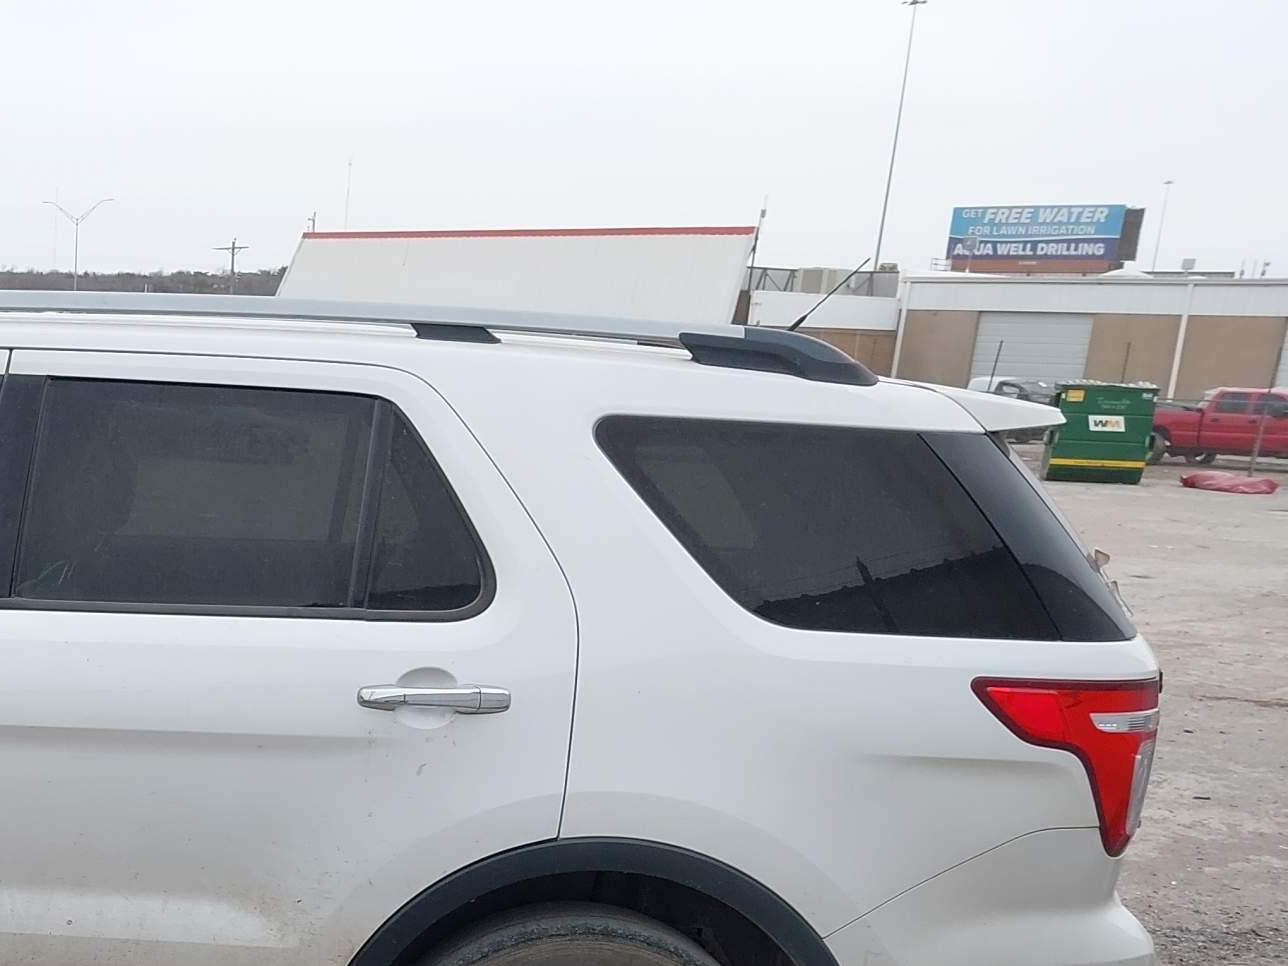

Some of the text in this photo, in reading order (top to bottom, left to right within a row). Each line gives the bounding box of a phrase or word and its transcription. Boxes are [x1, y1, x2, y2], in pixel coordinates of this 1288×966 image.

[962, 207, 1109, 224] GET FREE WATER
[968, 225, 1096, 236] FOR LAWN IRRIGATION
[953, 243, 1105, 255] AUA WELL DRILLING
